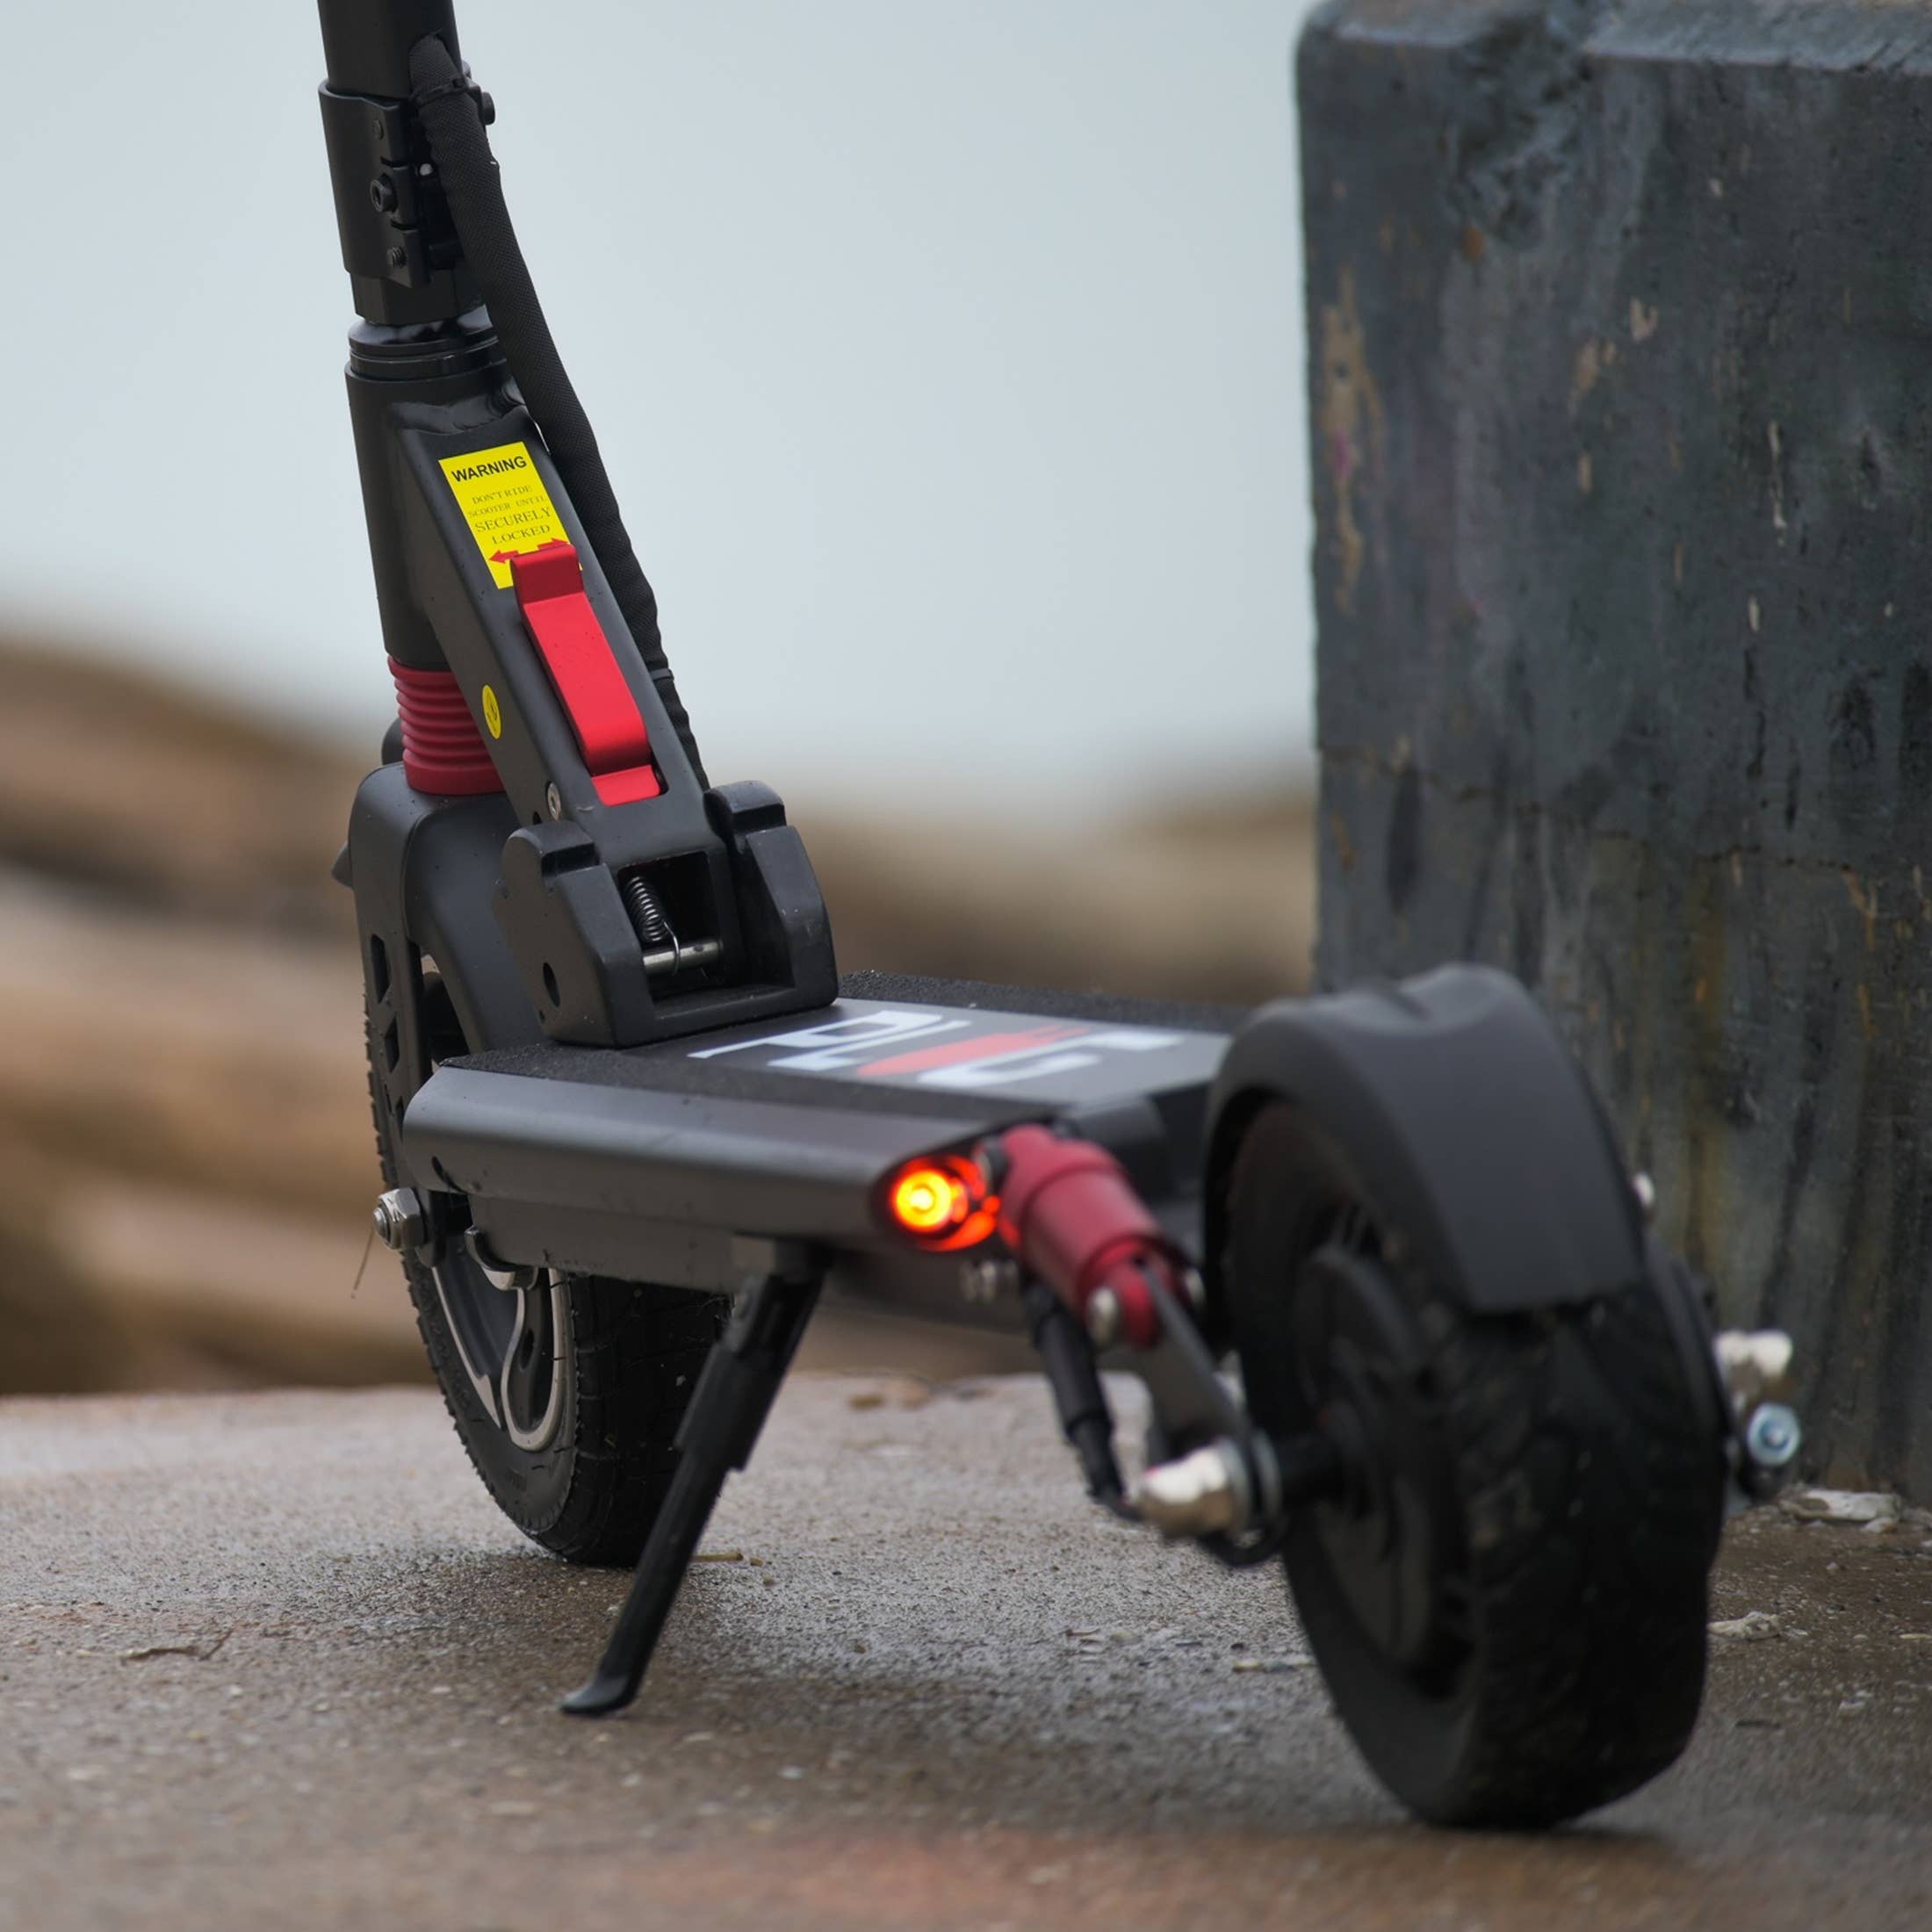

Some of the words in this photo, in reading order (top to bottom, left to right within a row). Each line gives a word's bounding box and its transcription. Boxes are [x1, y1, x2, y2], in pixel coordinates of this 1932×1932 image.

[451, 456, 527, 482] WARNING
[468, 502, 510, 517] SCOOTER
[515, 495, 544, 507] UNTIL
[475, 507, 551, 532] SECURELY
[492, 524, 551, 544] LOCKED
